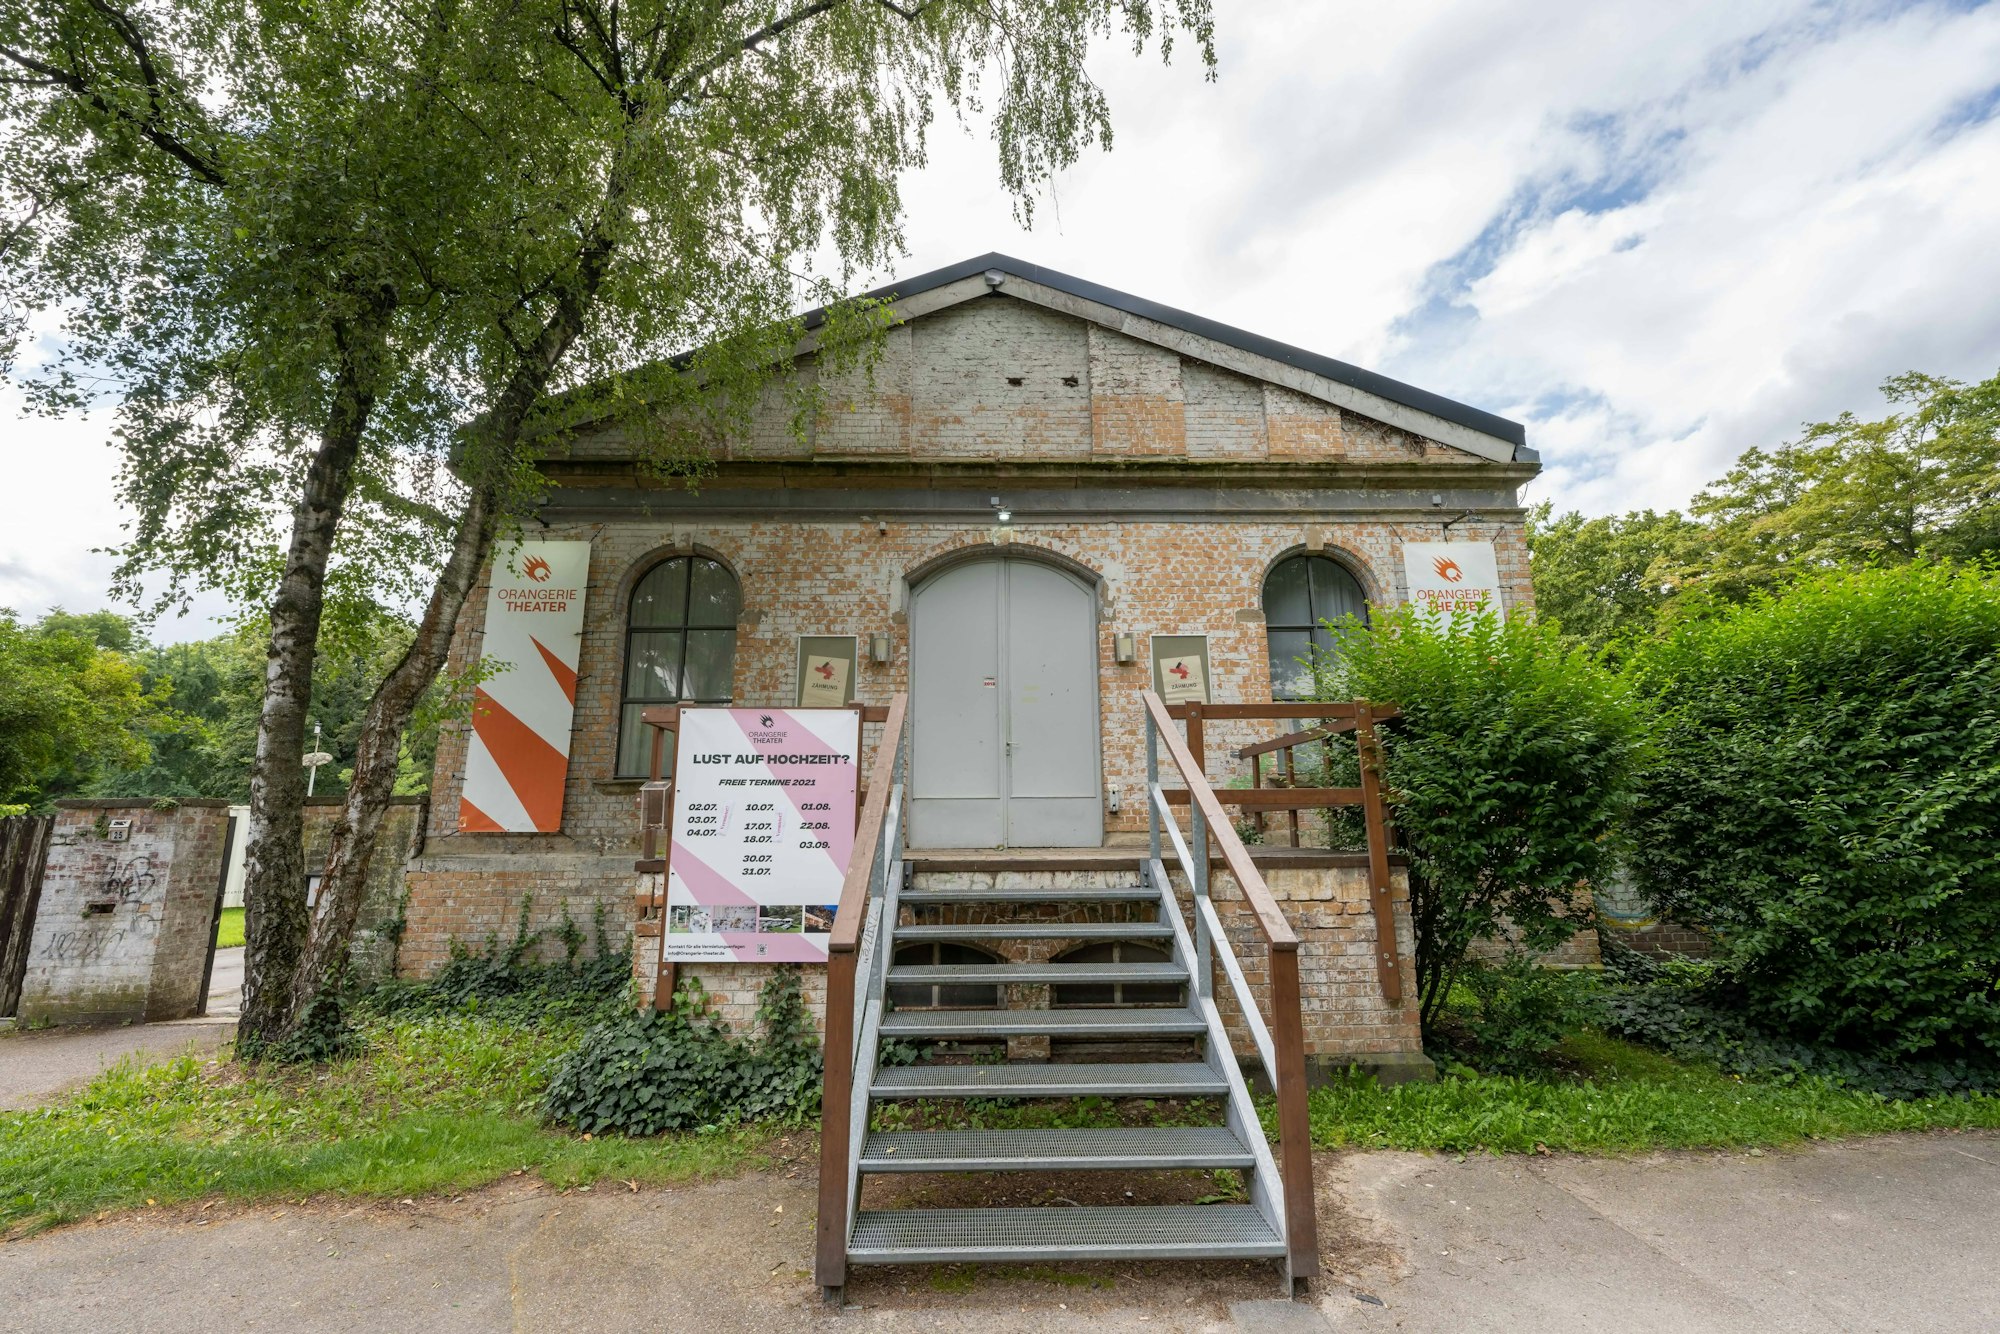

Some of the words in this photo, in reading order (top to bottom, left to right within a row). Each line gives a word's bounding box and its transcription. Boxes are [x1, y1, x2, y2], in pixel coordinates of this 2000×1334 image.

[498, 589, 577, 600] ORANGERIE
[506, 601, 567, 612] THEATER
[693, 754, 731, 764] LUST
[735, 754, 765, 764] AUF
[767, 754, 850, 764] HOCHZEIT?
[688, 803, 718, 811] 02.07.
[745, 803, 774, 811] 10.07.
[801, 803, 831, 811] 01.08.
[687, 816, 717, 824] 03.07.
[799, 822, 830, 830] 22.08.
[113, 831, 123, 840] 25
[686, 829, 717, 837] 04.07.
[743, 835, 773, 843] 18.07.
[799, 841, 830, 849] 03.09.
[742, 855, 773, 863] 30.07.
[742, 868, 771, 876] 31.07.
